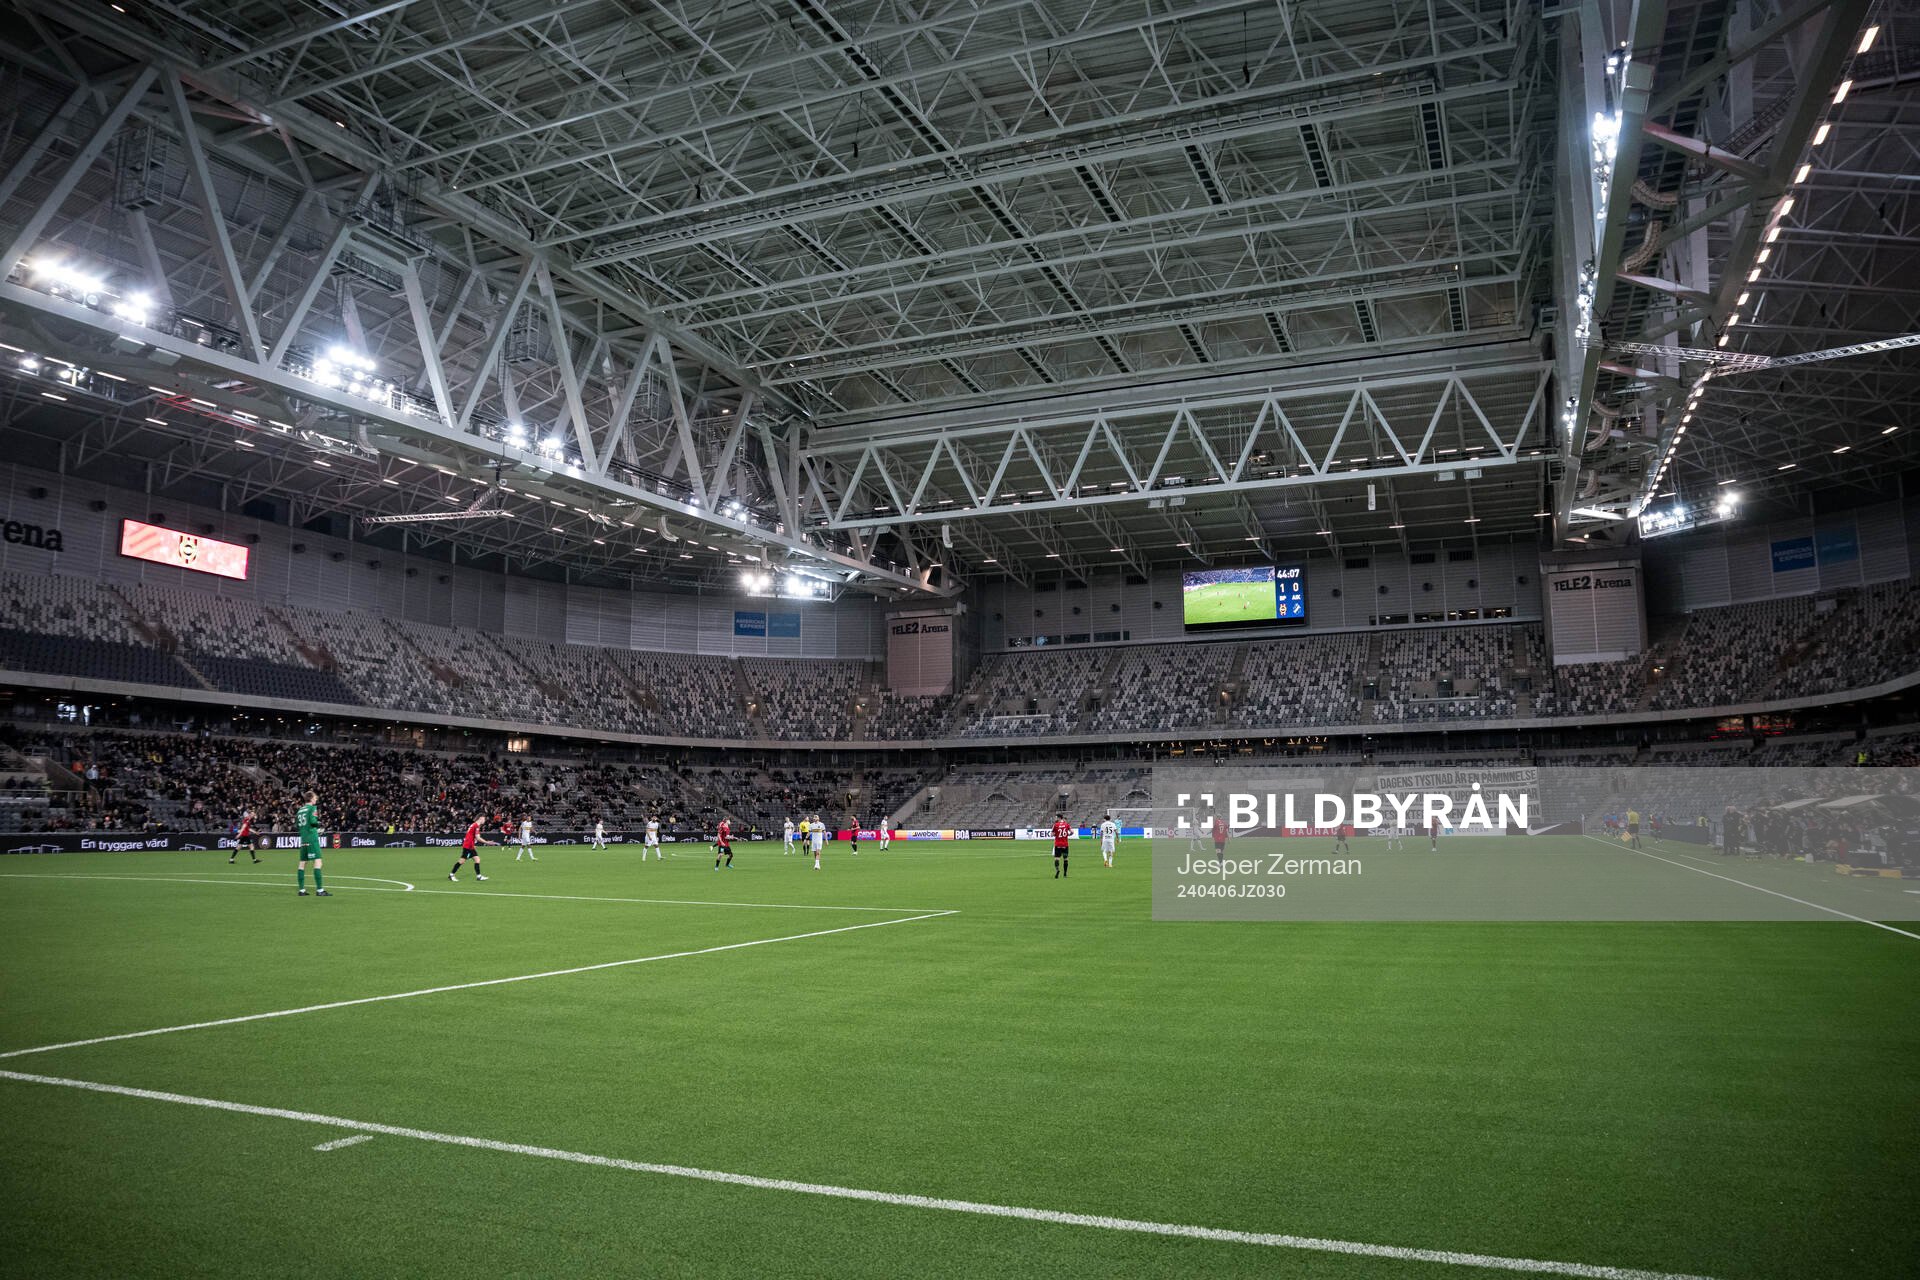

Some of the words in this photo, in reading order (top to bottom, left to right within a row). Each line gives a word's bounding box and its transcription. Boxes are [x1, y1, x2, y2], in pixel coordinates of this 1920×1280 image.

[1277, 569, 1300, 578] 44:07
[1280, 583, 1285, 593] 1
[1293, 582, 1299, 592] 0
[1554, 575, 1592, 591] TELE2
[1594, 578, 1632, 589] Arena
[892, 622, 919, 635] TELE2
[921, 624, 949, 634] Arena
[1380, 775, 1413, 789] DAGENS
[1415, 773, 1453, 787] TYSTNAD
[1455, 771, 1467, 784] ÄR
[1468, 773, 1480, 784] EN
[1482, 769, 1536, 784] PÅMINNELSE
[916, 830, 939, 838] weber
[1057, 828, 1068, 838] 26
[1290, 827, 1339, 836] BAUHAU
[1368, 827, 1416, 836] staum
[81, 839, 96, 849] En
[98, 841, 144, 852] tryggare
[146, 838, 168, 848] vård
[276, 837, 327, 848] ALLSVAN
[358, 838, 376, 846] Heba
[426, 836, 435, 845] En
[436, 838, 462, 846] tryggare
